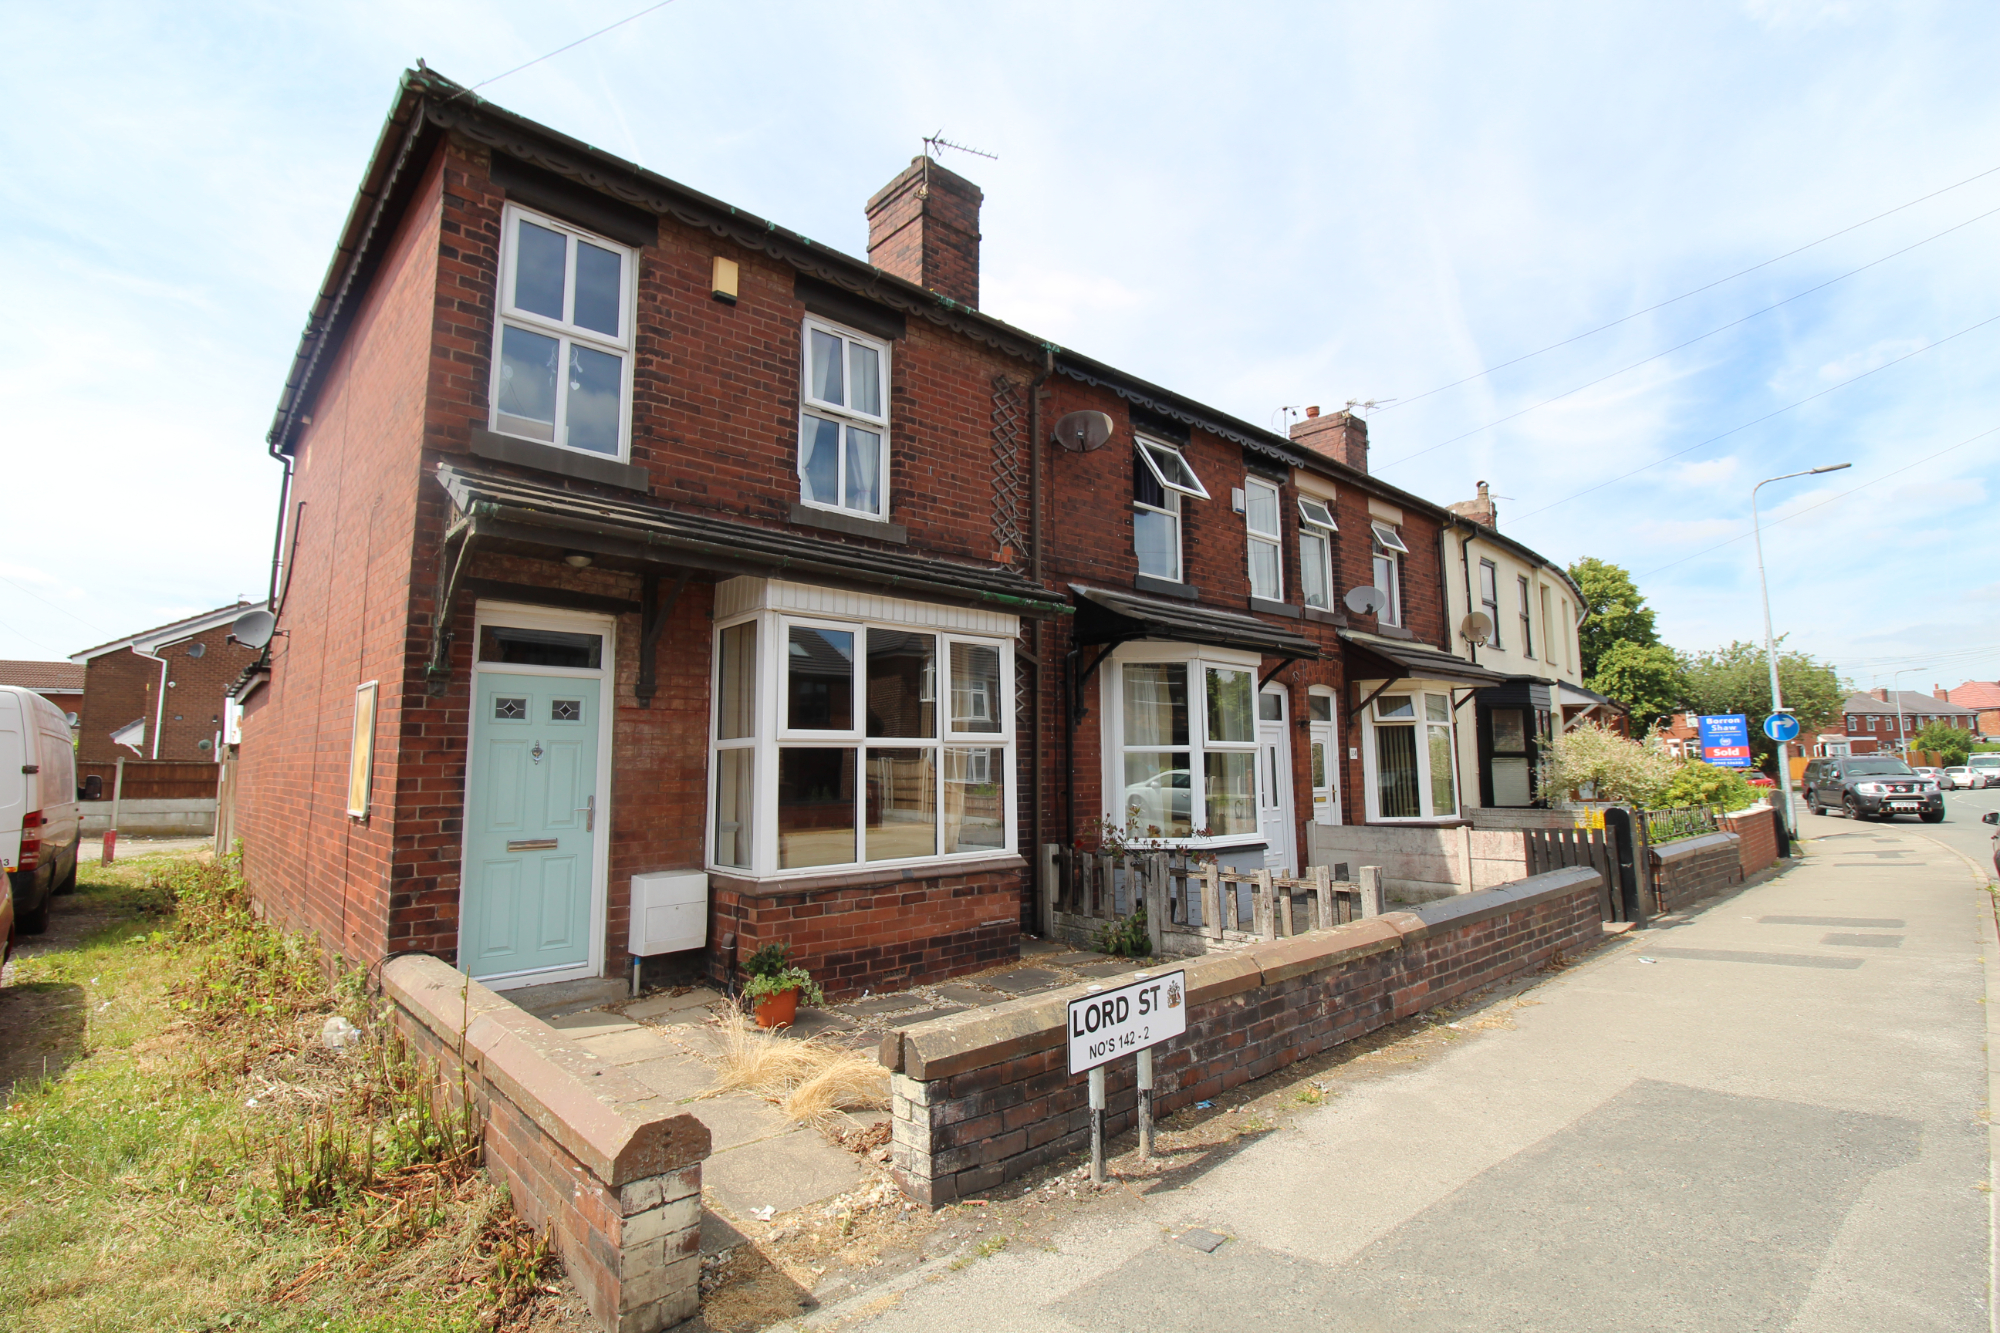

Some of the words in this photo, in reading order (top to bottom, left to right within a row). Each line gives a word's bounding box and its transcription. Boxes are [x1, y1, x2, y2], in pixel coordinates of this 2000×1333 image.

[1713, 747, 1740, 757] Sold
[1073, 995, 1129, 1038] LORD
[1138, 985, 1161, 1016] ST
[1089, 1038, 1115, 1060] NO'S
[1118, 1031, 1136, 1049] 142
[1143, 1026, 1149, 1040] 2
